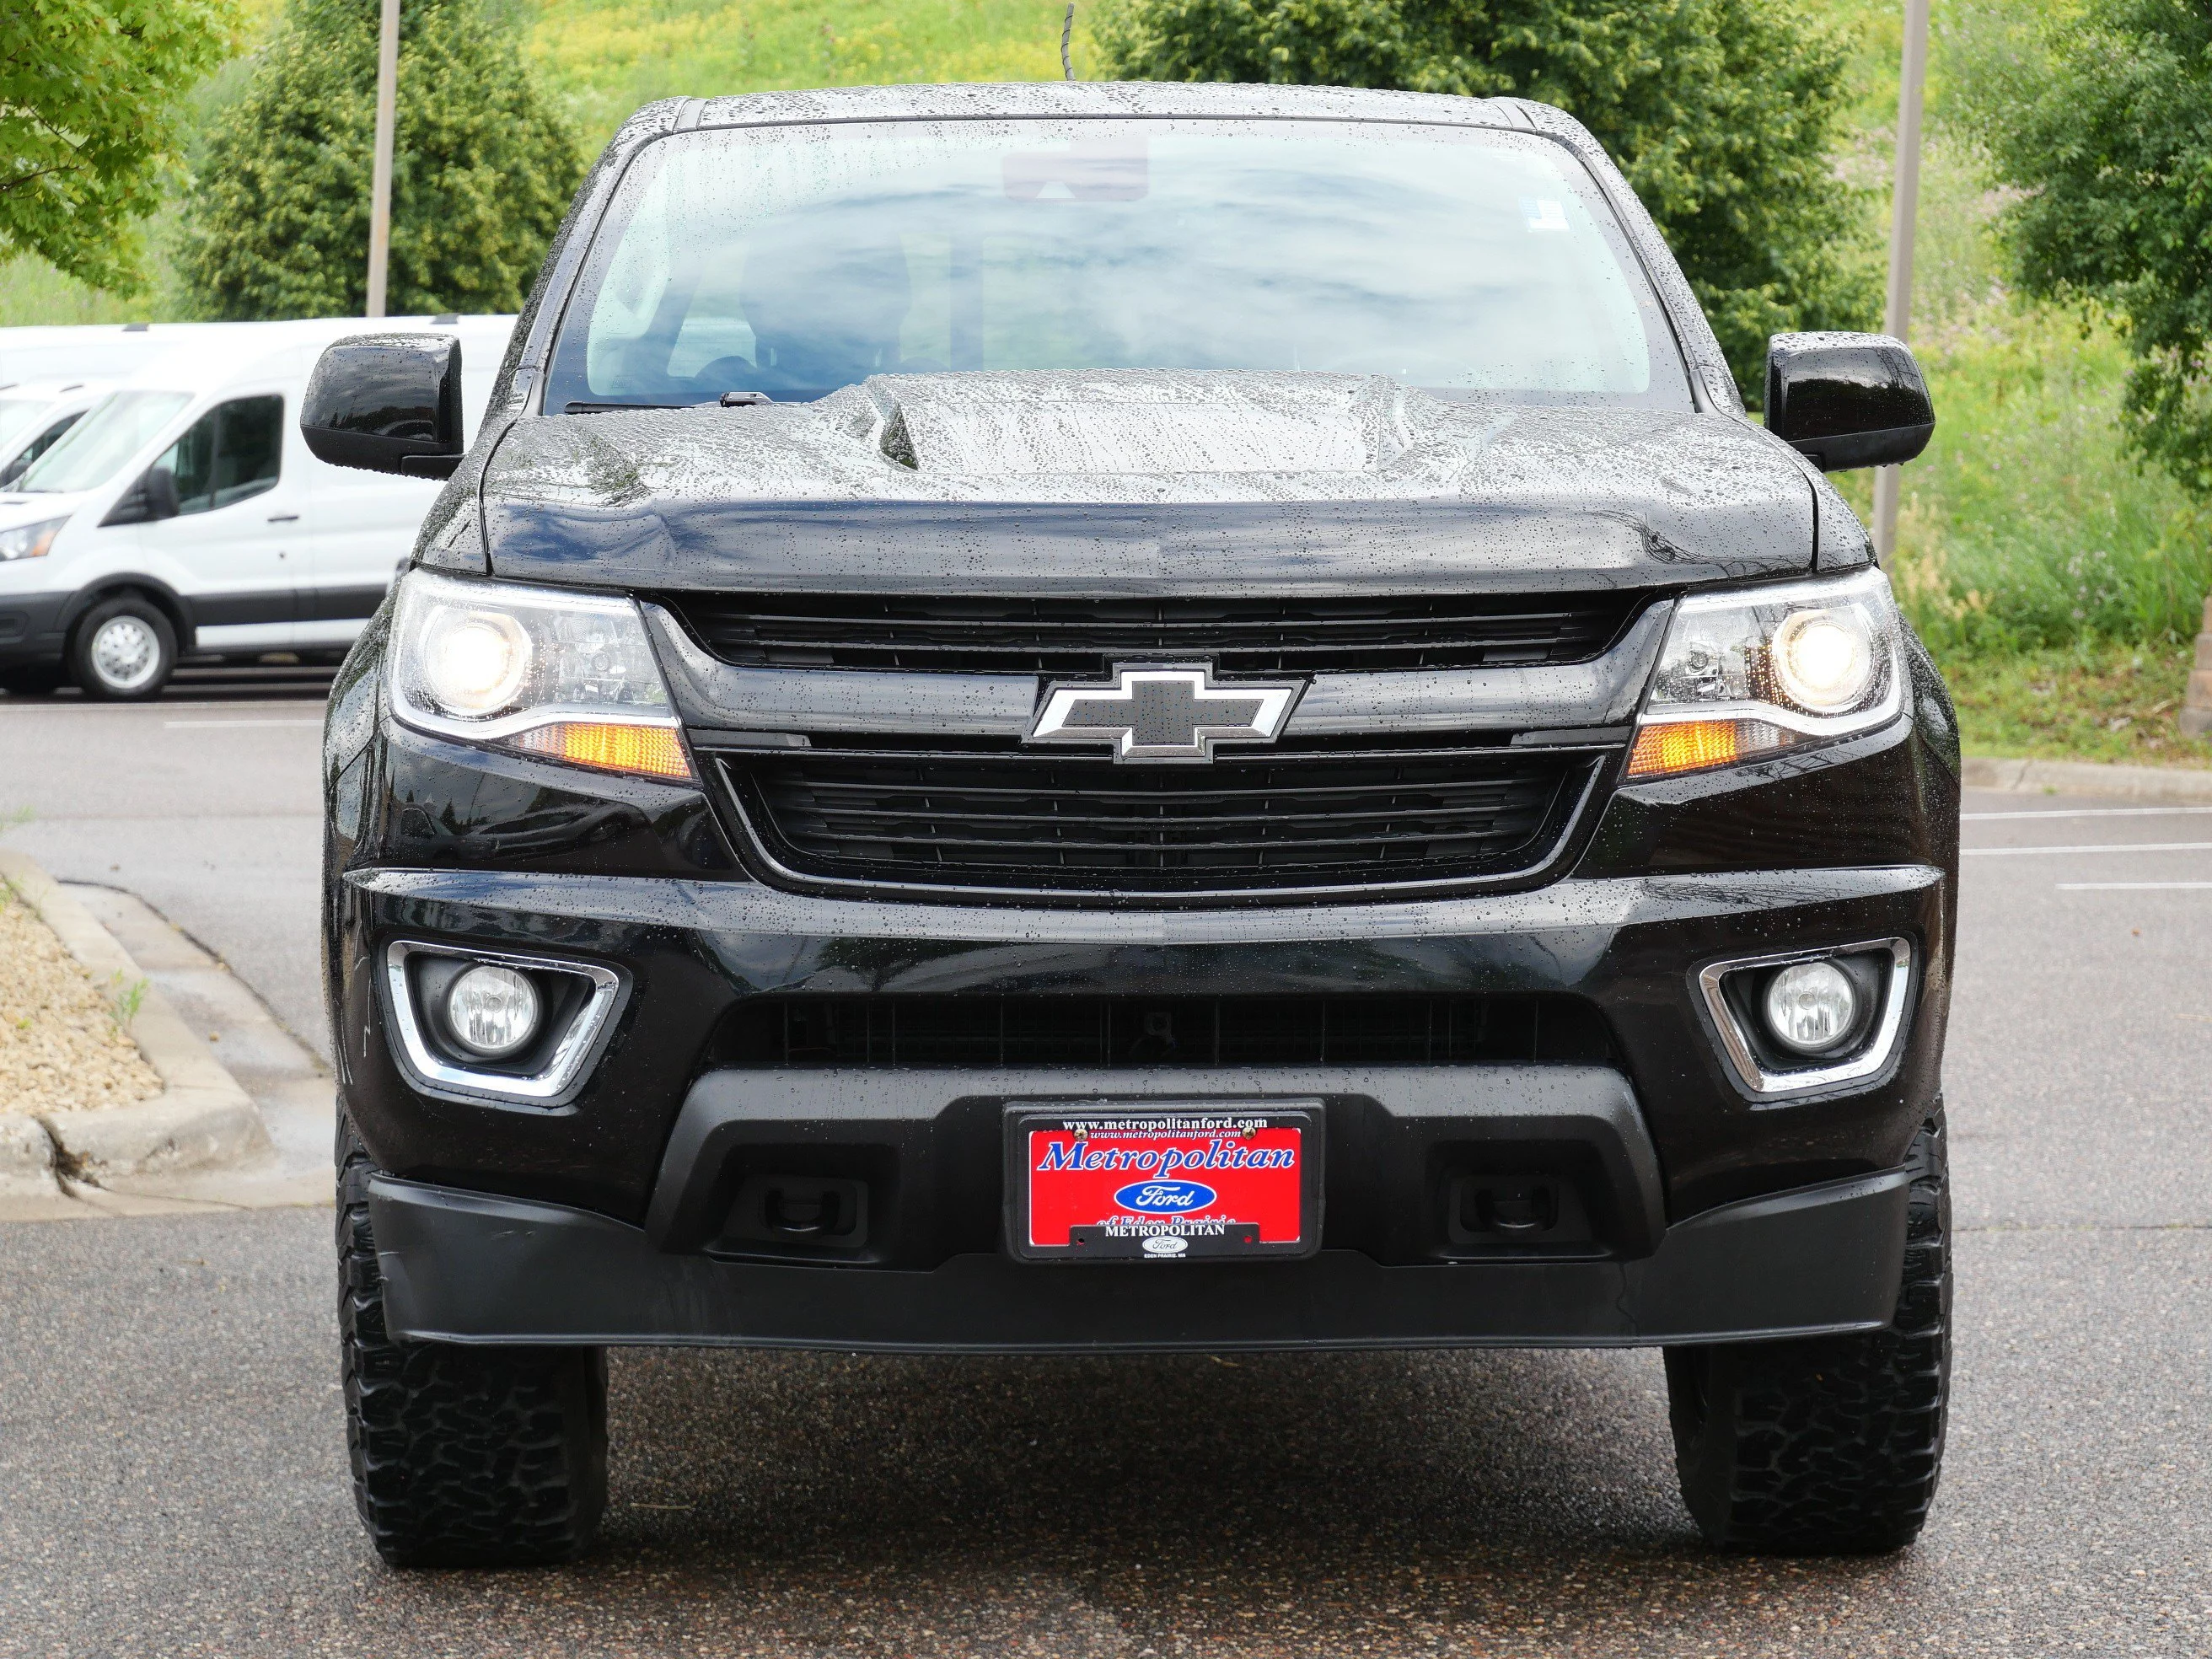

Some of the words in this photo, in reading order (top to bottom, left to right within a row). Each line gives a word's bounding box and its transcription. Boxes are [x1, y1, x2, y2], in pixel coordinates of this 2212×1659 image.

[1063, 1117, 1267, 1132] www.metropolitanford.com
[1090, 1129, 1242, 1141] www.metropolitanford.com
[1037, 1139, 1295, 1179] Metropolitan
[1136, 1185, 1195, 1205] Ford
[1105, 1224, 1226, 1237] METROPOLITAN
